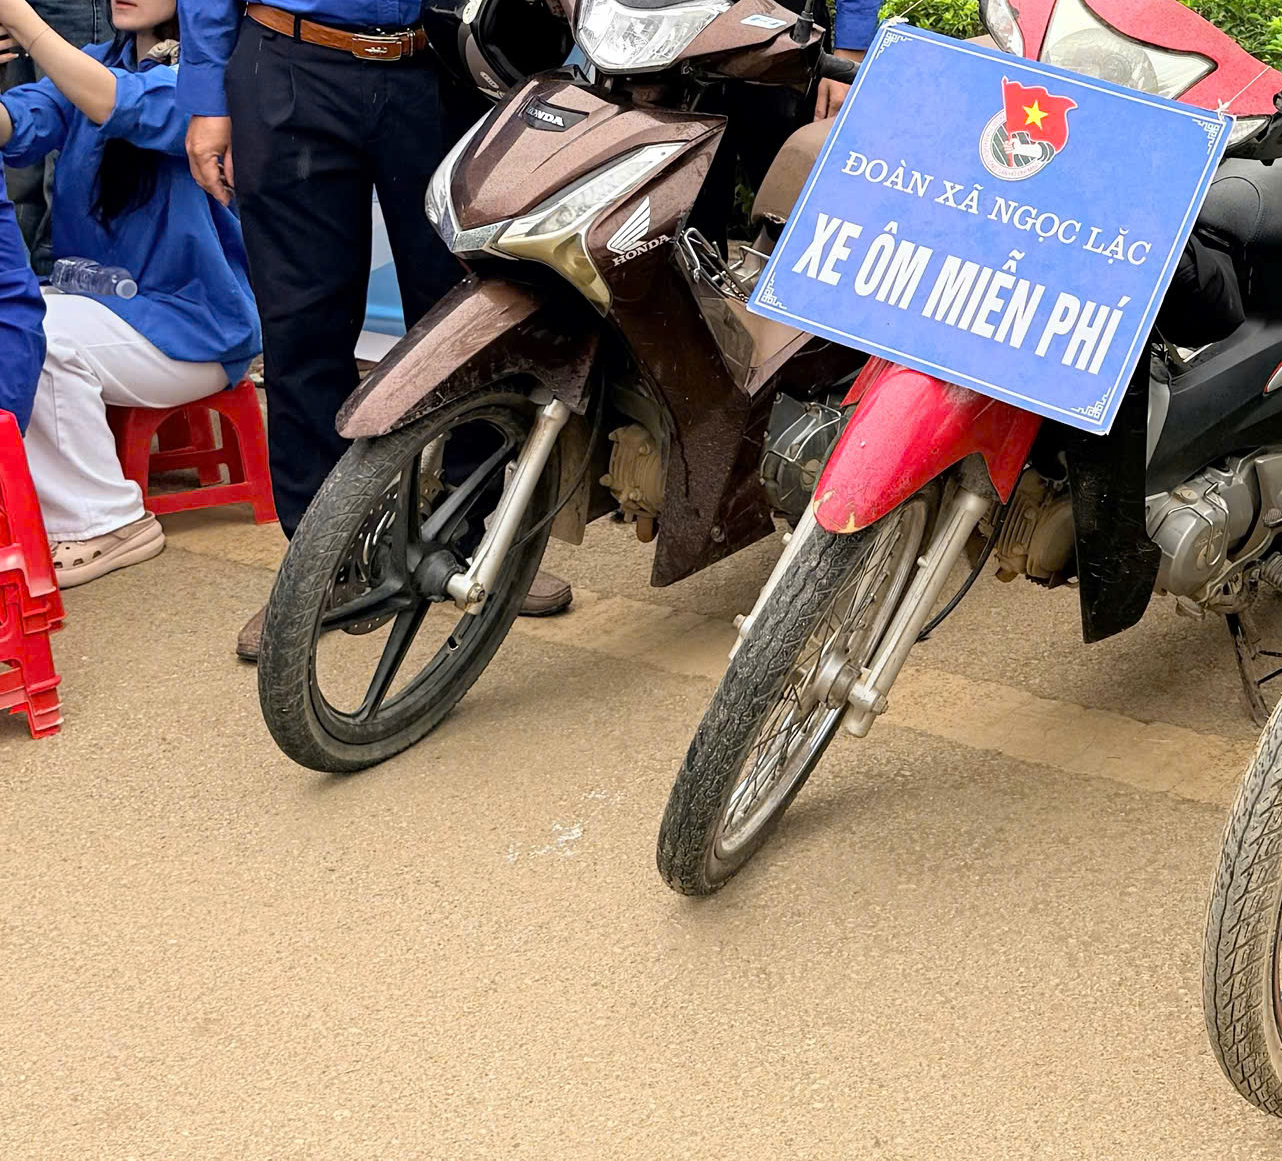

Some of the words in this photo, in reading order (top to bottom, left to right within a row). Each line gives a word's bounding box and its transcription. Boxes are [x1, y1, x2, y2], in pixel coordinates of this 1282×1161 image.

[611, 234, 671, 267] HONDA
[841, 150, 934, 198] ĐOÀN
[935, 179, 984, 215] XÃ
[987, 195, 1082, 245] NGỌC
[1083, 227, 1152, 266] LẶC
[791, 212, 863, 286] XE
[854, 220, 934, 311] ÔM
[921, 249, 1046, 350] MIỄN
[1034, 291, 1132, 376] PHÍ
